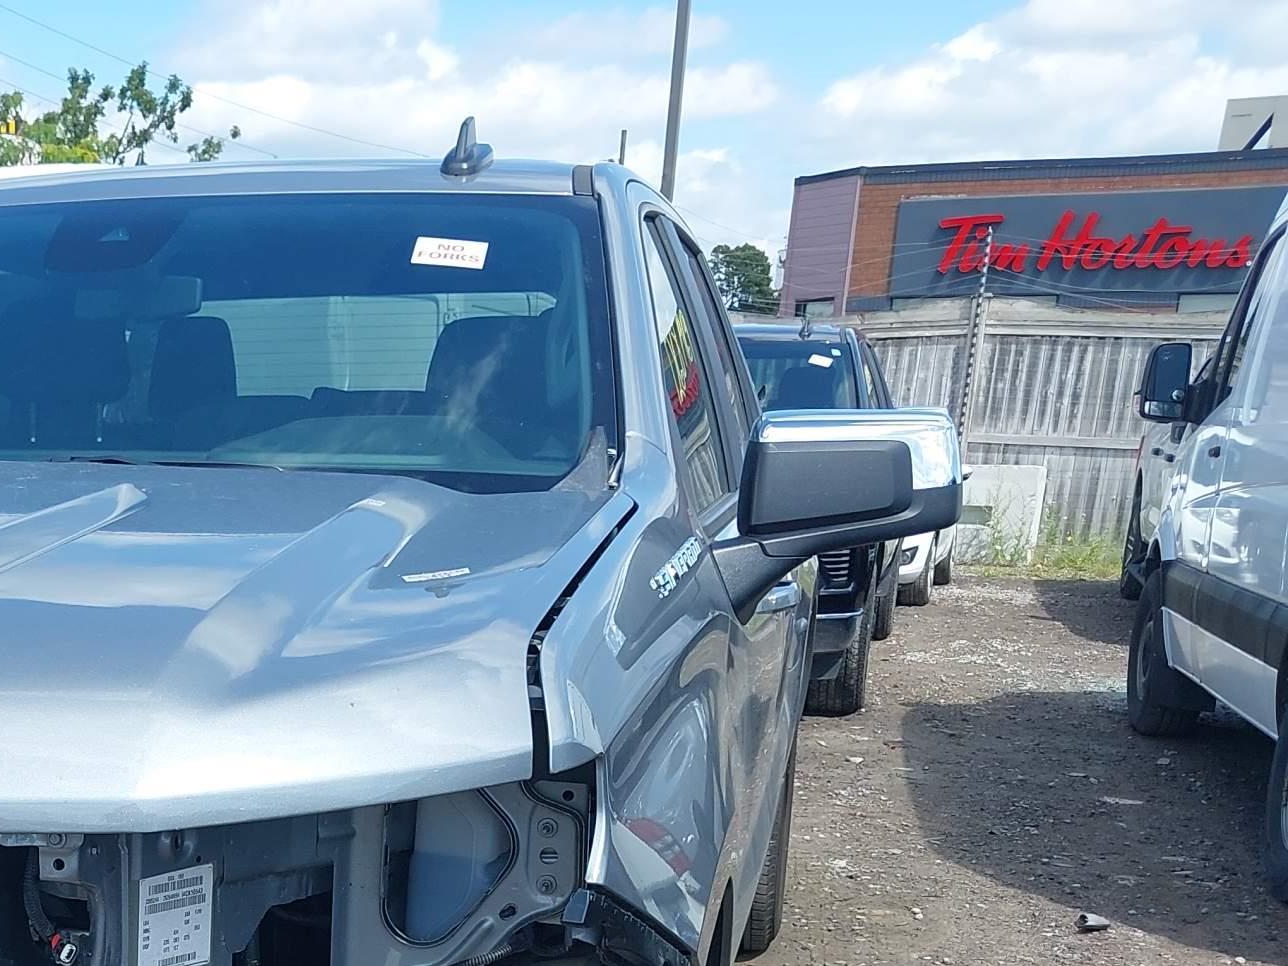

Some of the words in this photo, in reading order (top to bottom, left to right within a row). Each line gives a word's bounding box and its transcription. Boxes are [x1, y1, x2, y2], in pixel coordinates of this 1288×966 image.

[437, 243, 465, 253] NO
[937, 214, 1029, 274] Tim
[1036, 209, 1253, 272] Hortons
[417, 250, 481, 263] FORKS
